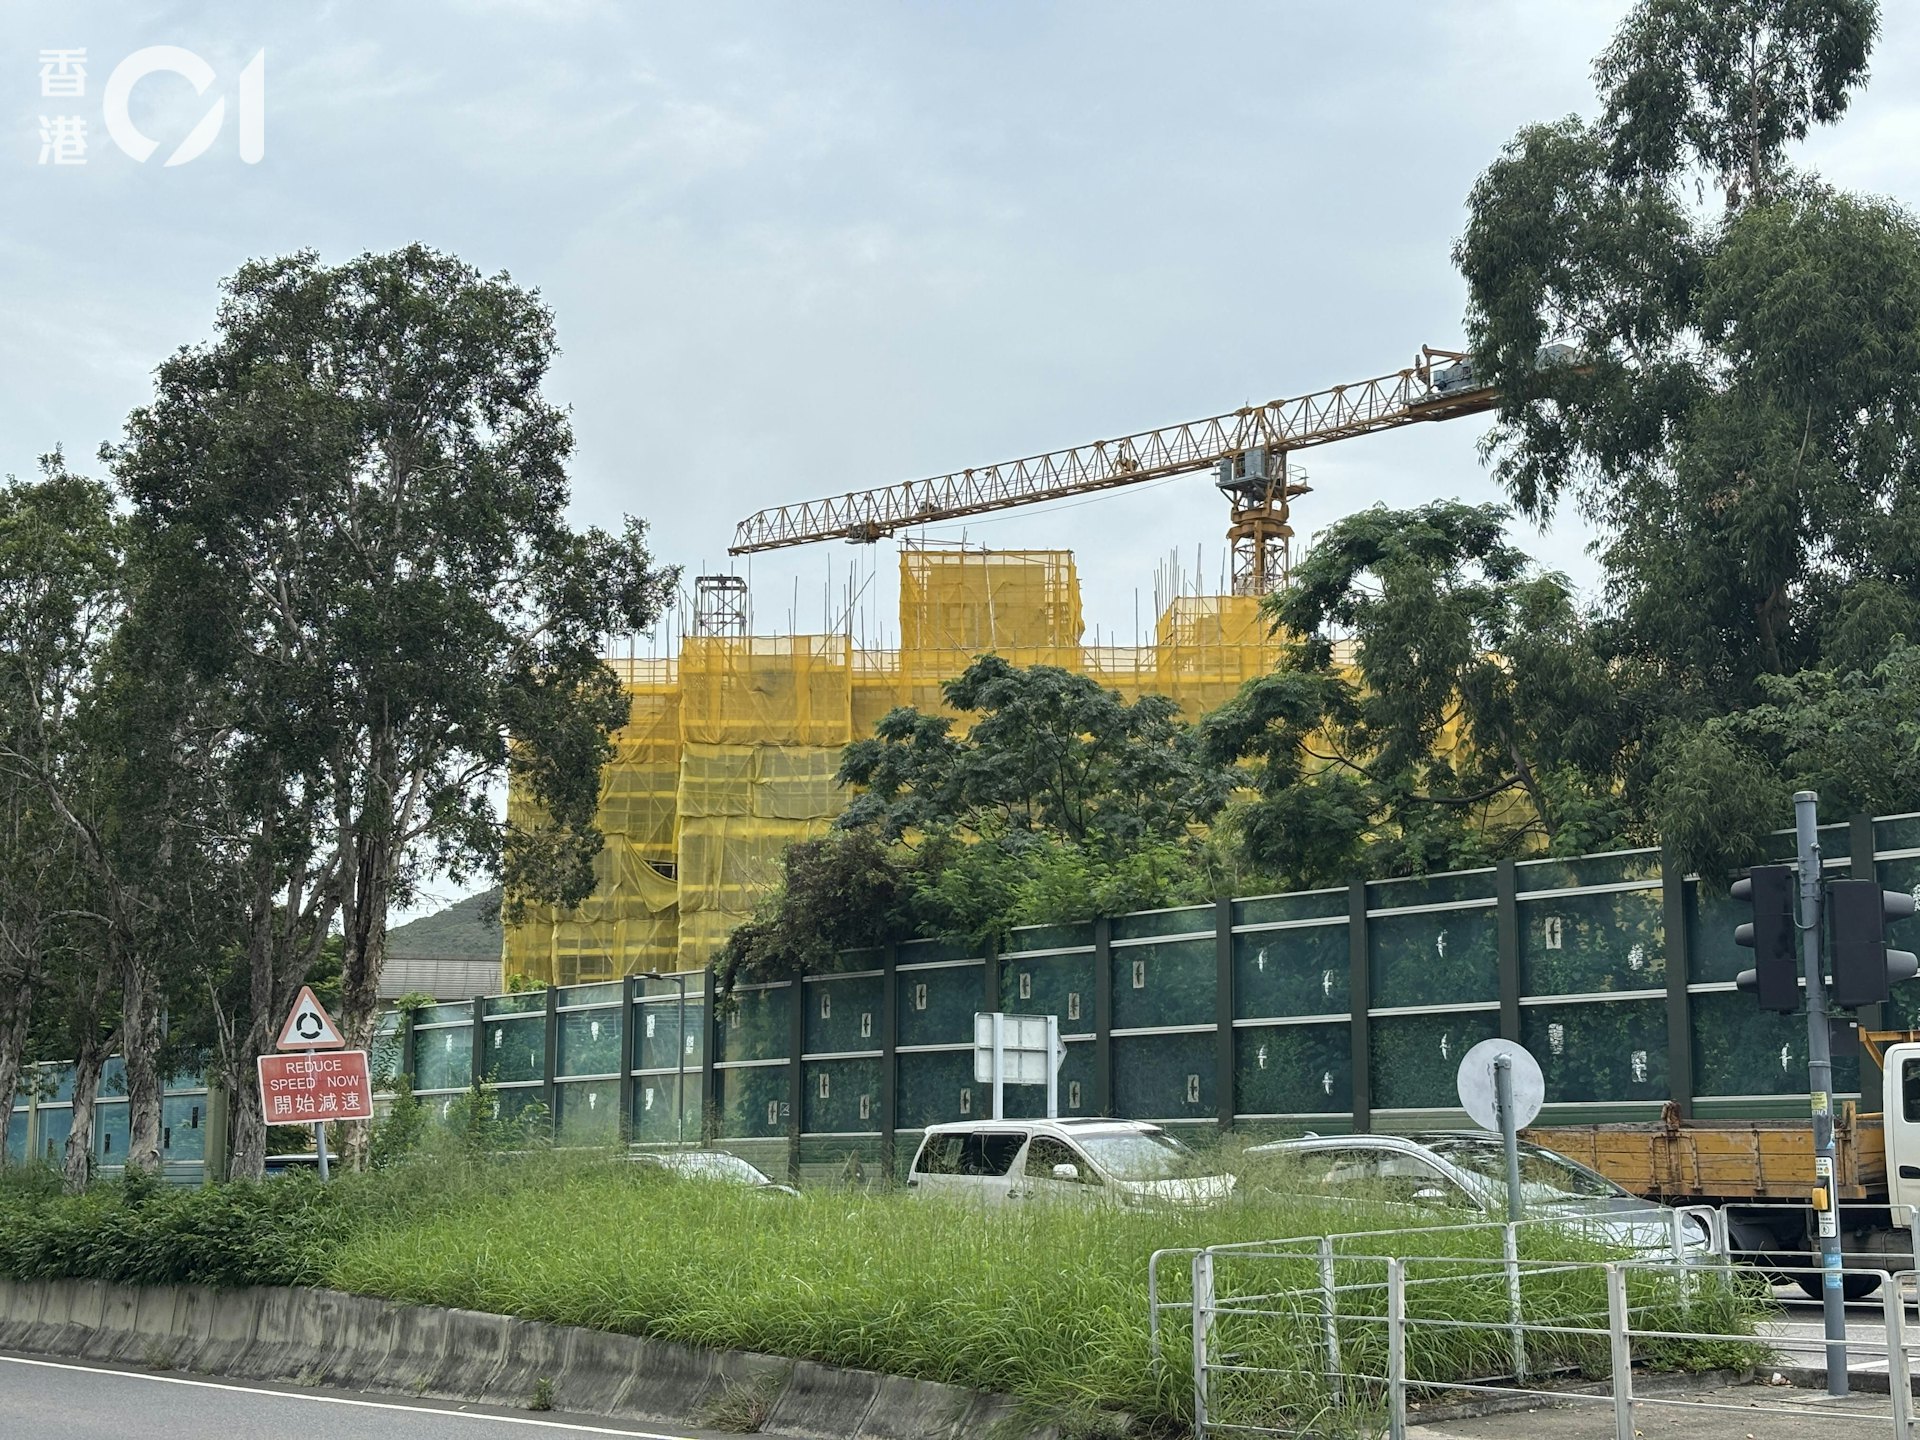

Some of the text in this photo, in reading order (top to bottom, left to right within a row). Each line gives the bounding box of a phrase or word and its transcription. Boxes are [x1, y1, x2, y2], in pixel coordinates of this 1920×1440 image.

[285, 1059, 342, 1074] REDUCE
[270, 1075, 360, 1091] SPEED NOW
[273, 1091, 361, 1115] 開始減速
